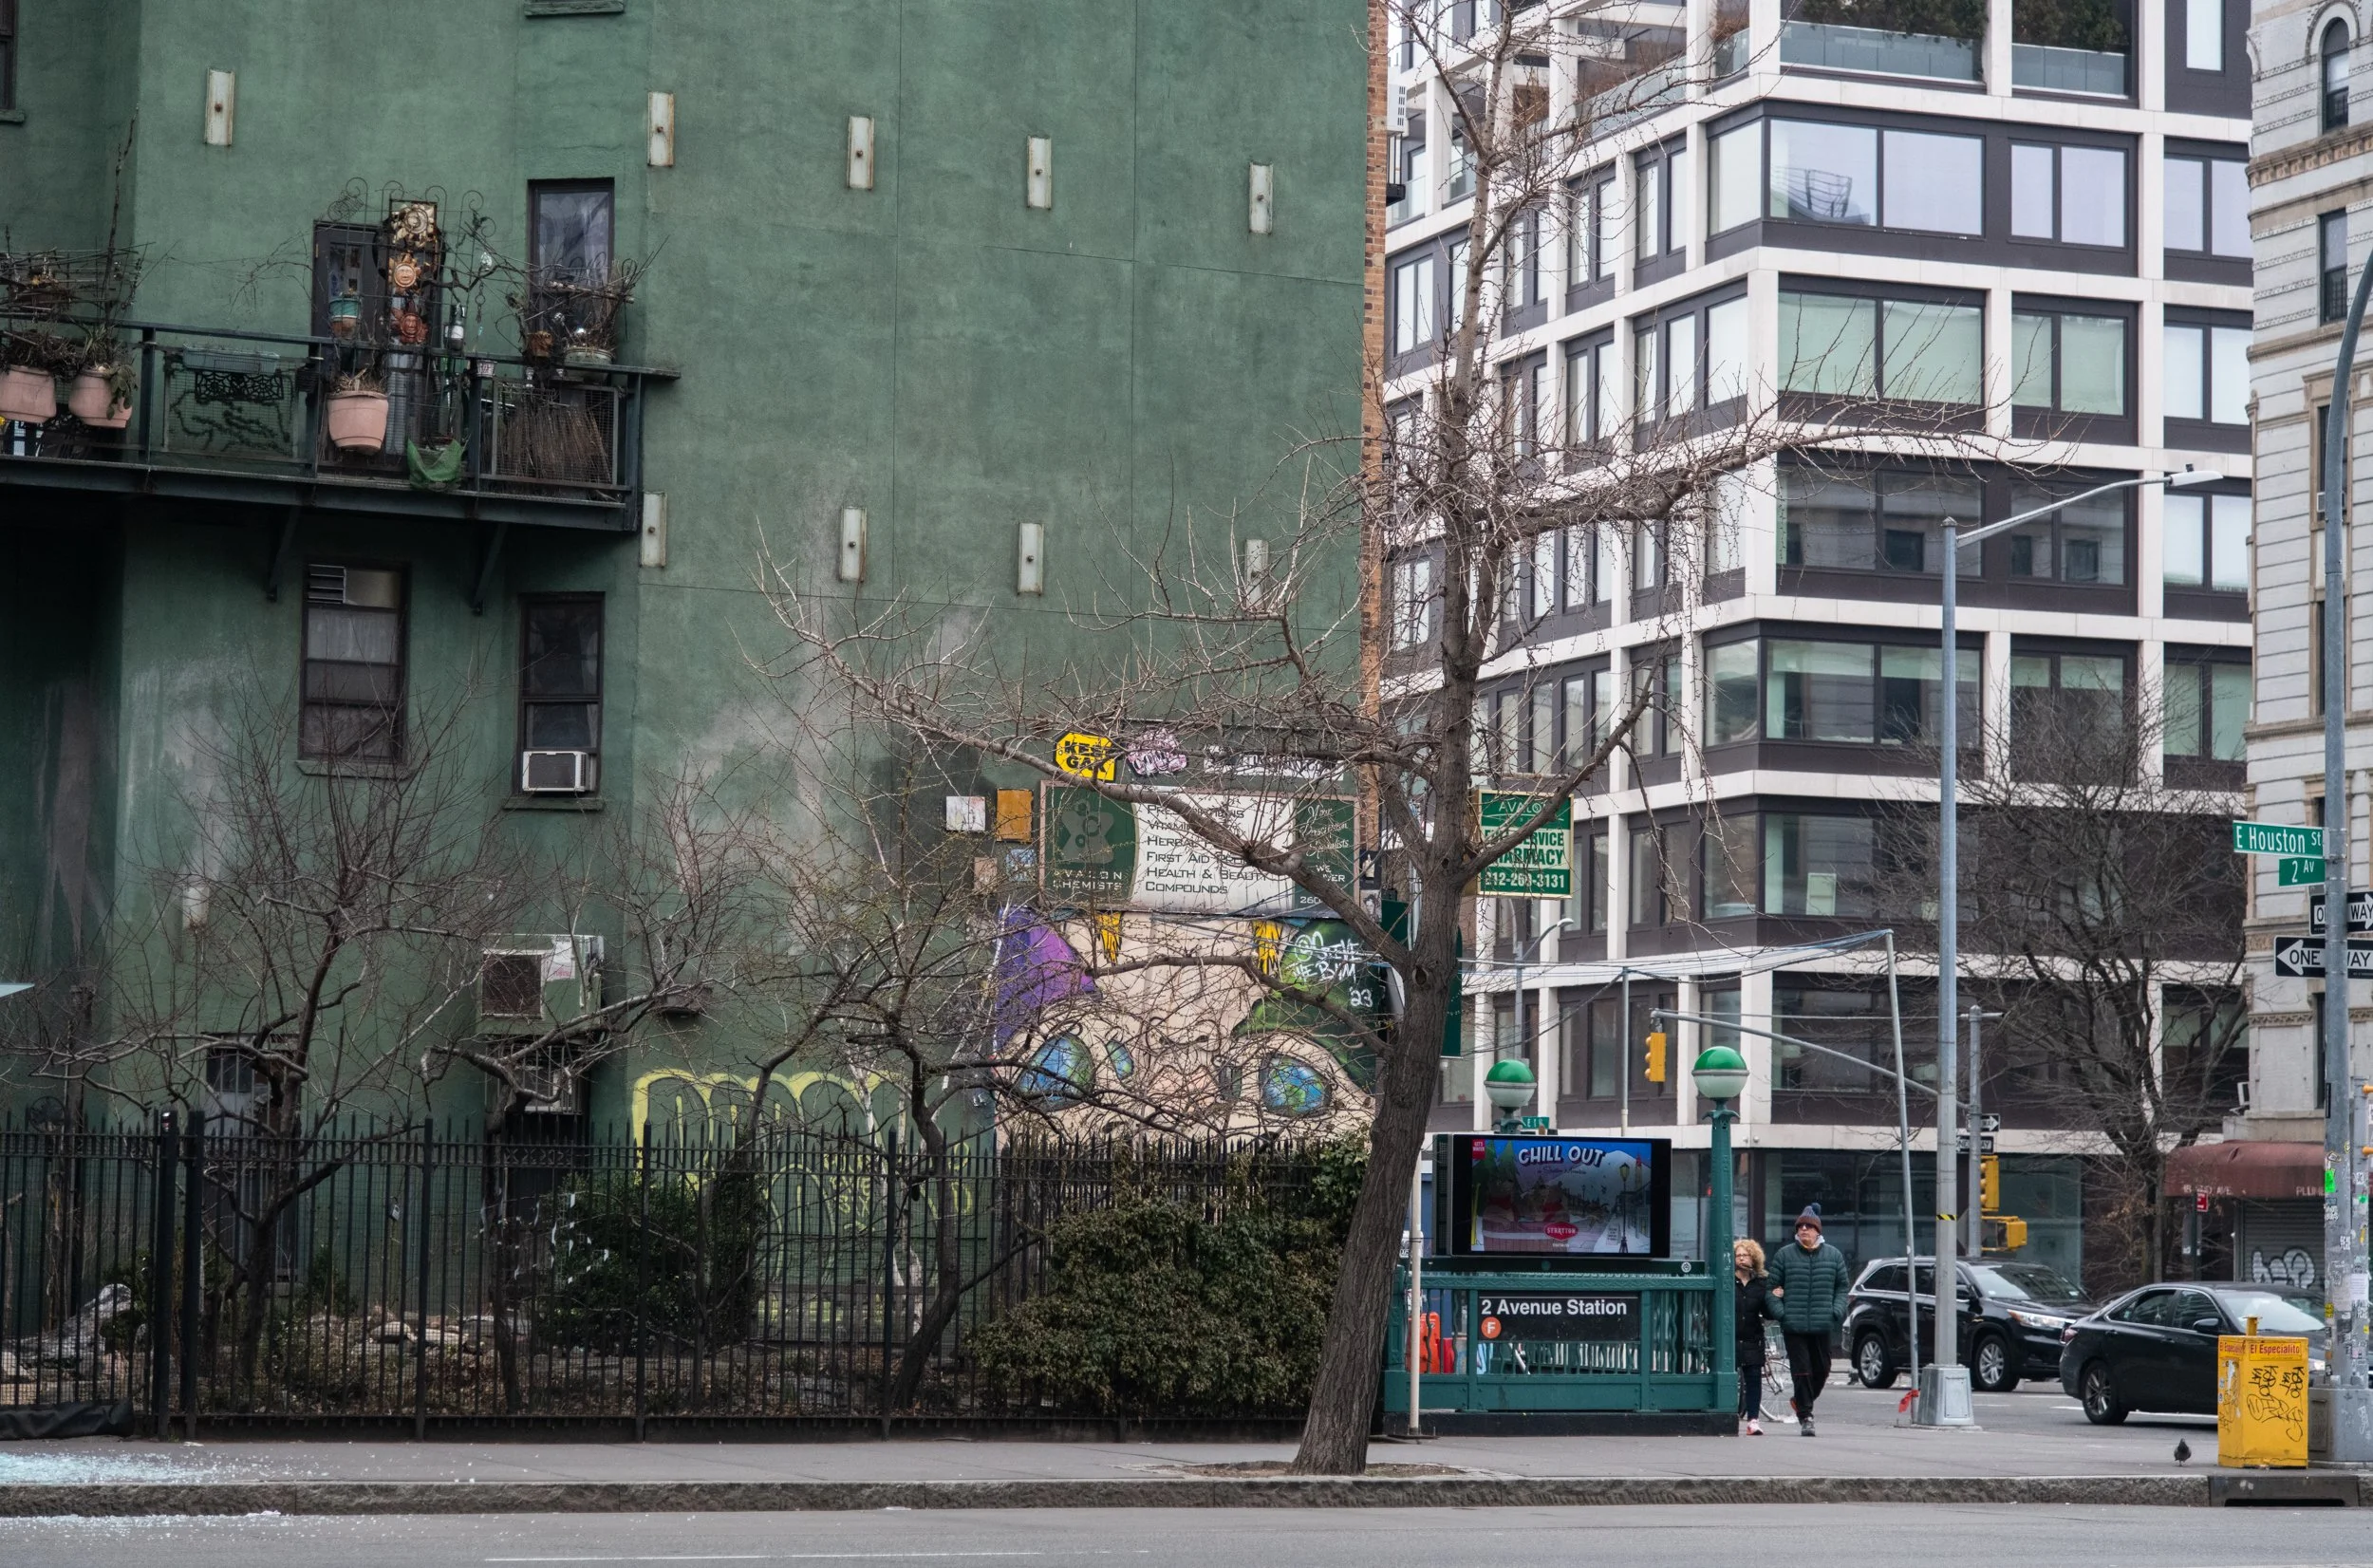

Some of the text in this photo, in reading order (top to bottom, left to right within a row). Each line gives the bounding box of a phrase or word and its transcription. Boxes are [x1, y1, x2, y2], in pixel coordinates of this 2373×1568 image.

[1499, 800, 1548, 813] AVALO
[1147, 836, 1199, 848] HERBAL
[1522, 831, 1564, 847] ERVICE
[2235, 826, 2243, 849] E
[2249, 827, 2306, 853] Houston
[1147, 852, 1183, 863] FIRST
[1188, 853, 1210, 863] AID
[1496, 848, 1564, 866] ARMACY
[1147, 868, 1267, 881] HEALTH & BEAUTY
[2290, 860, 2299, 883] 2
[1145, 882, 1228, 894] COMPOUNDS
[2289, 949, 2371, 967] ONE AY
[1519, 1145, 1605, 1167] CHILL OUT
[1481, 1298, 1627, 1316] 2 Avenue Station
[1486, 1321, 1496, 1335] F
[2250, 1344, 2301, 1355] El Especialito
